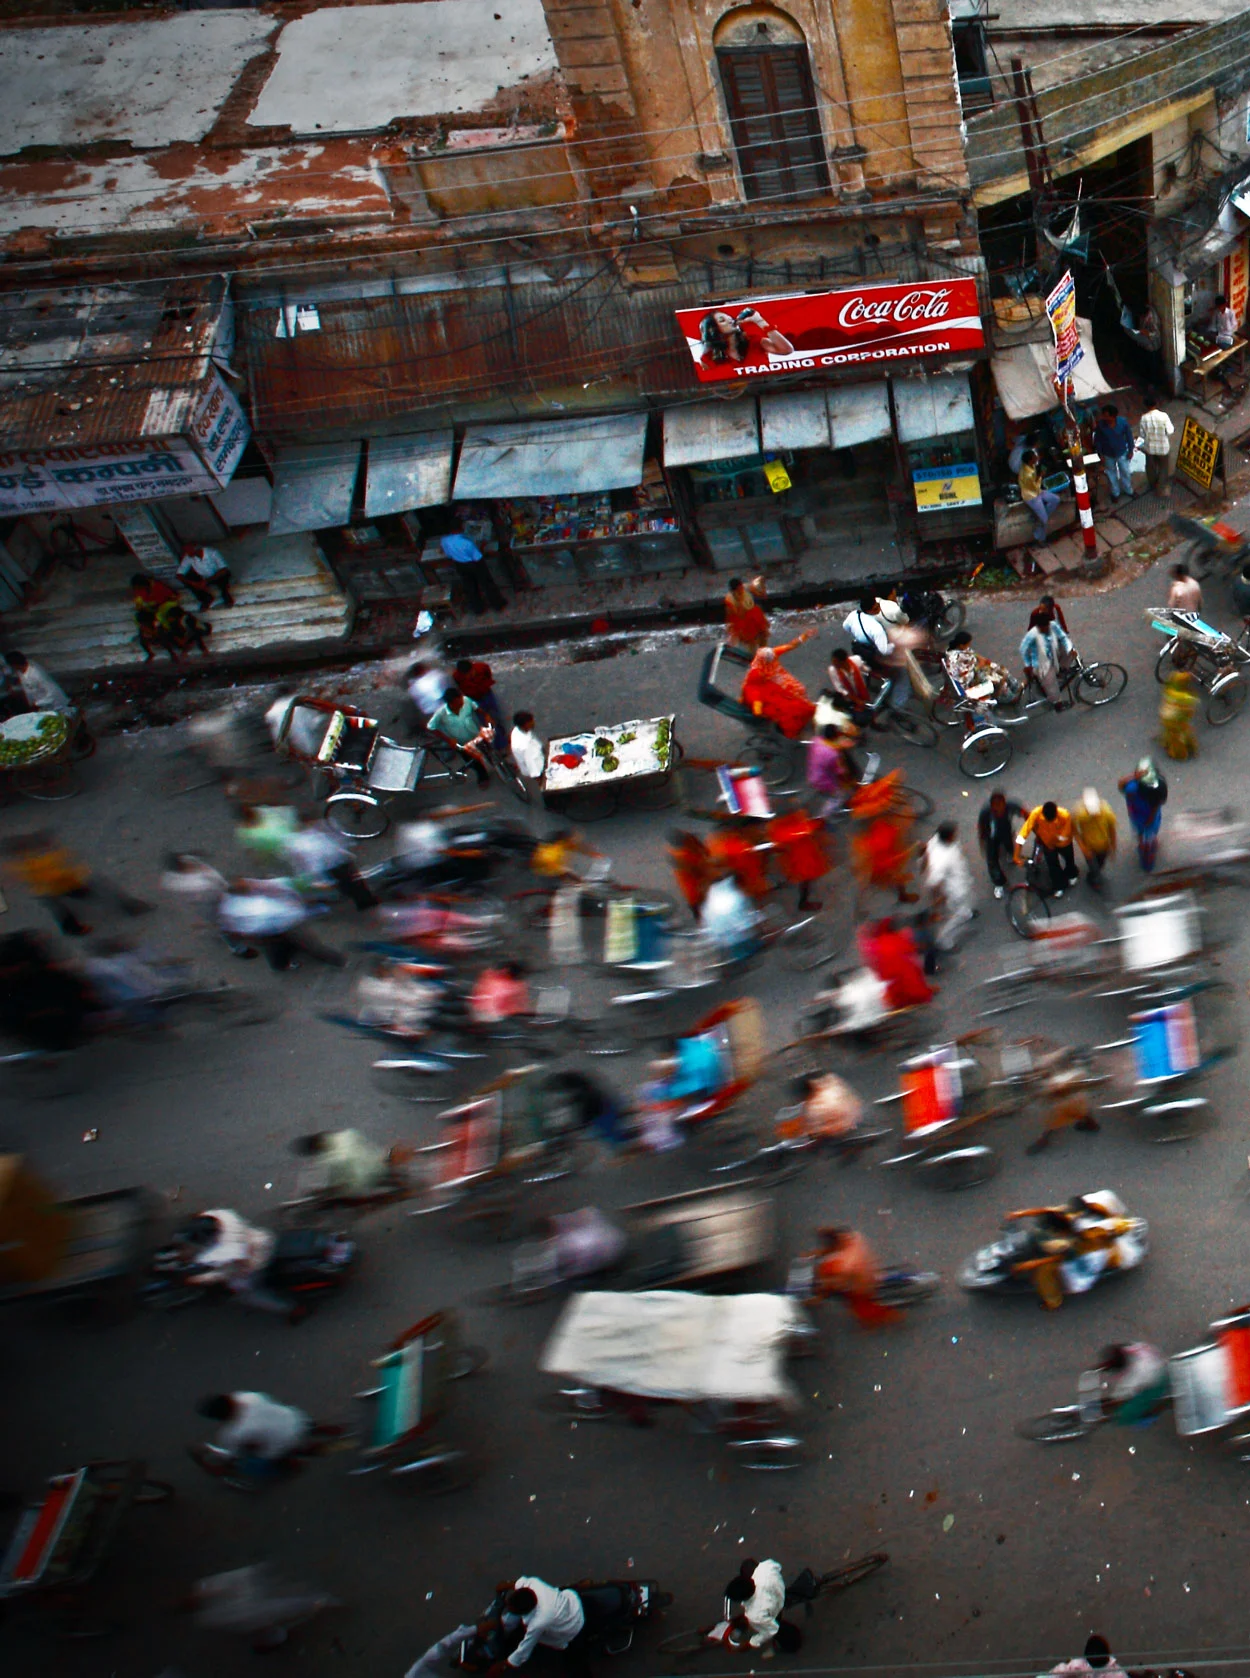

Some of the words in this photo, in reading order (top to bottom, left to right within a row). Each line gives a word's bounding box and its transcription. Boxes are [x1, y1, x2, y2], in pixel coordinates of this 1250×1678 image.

[838, 289, 953, 328] Coca-Cola
[733, 357, 815, 376] TRADING
[821, 342, 950, 366] CORPORATION
